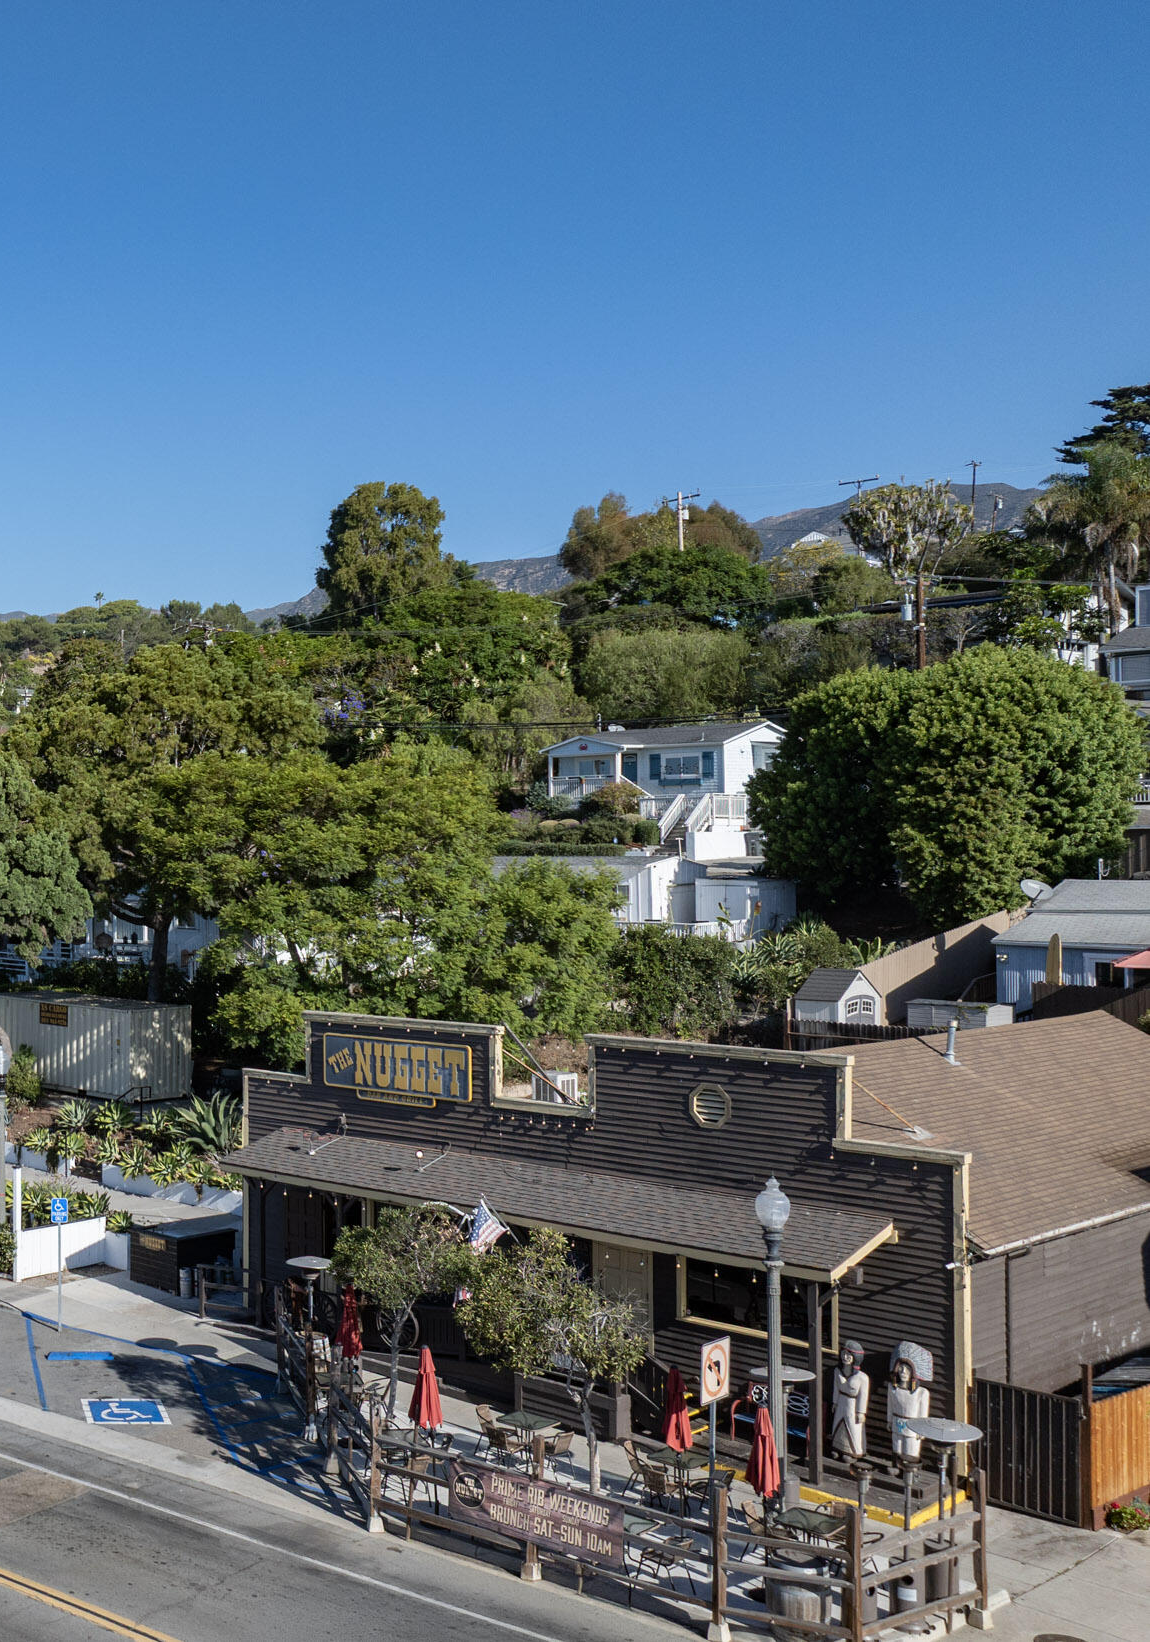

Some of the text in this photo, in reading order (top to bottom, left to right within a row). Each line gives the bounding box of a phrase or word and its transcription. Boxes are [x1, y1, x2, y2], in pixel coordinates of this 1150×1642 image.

[327, 1041, 465, 1097] THE NUGGET
[491, 1474, 610, 1526] PRIME RIB WEEKENDS
[489, 1503, 530, 1532] BRUNCH
[587, 1532, 612, 1557] 10AM
